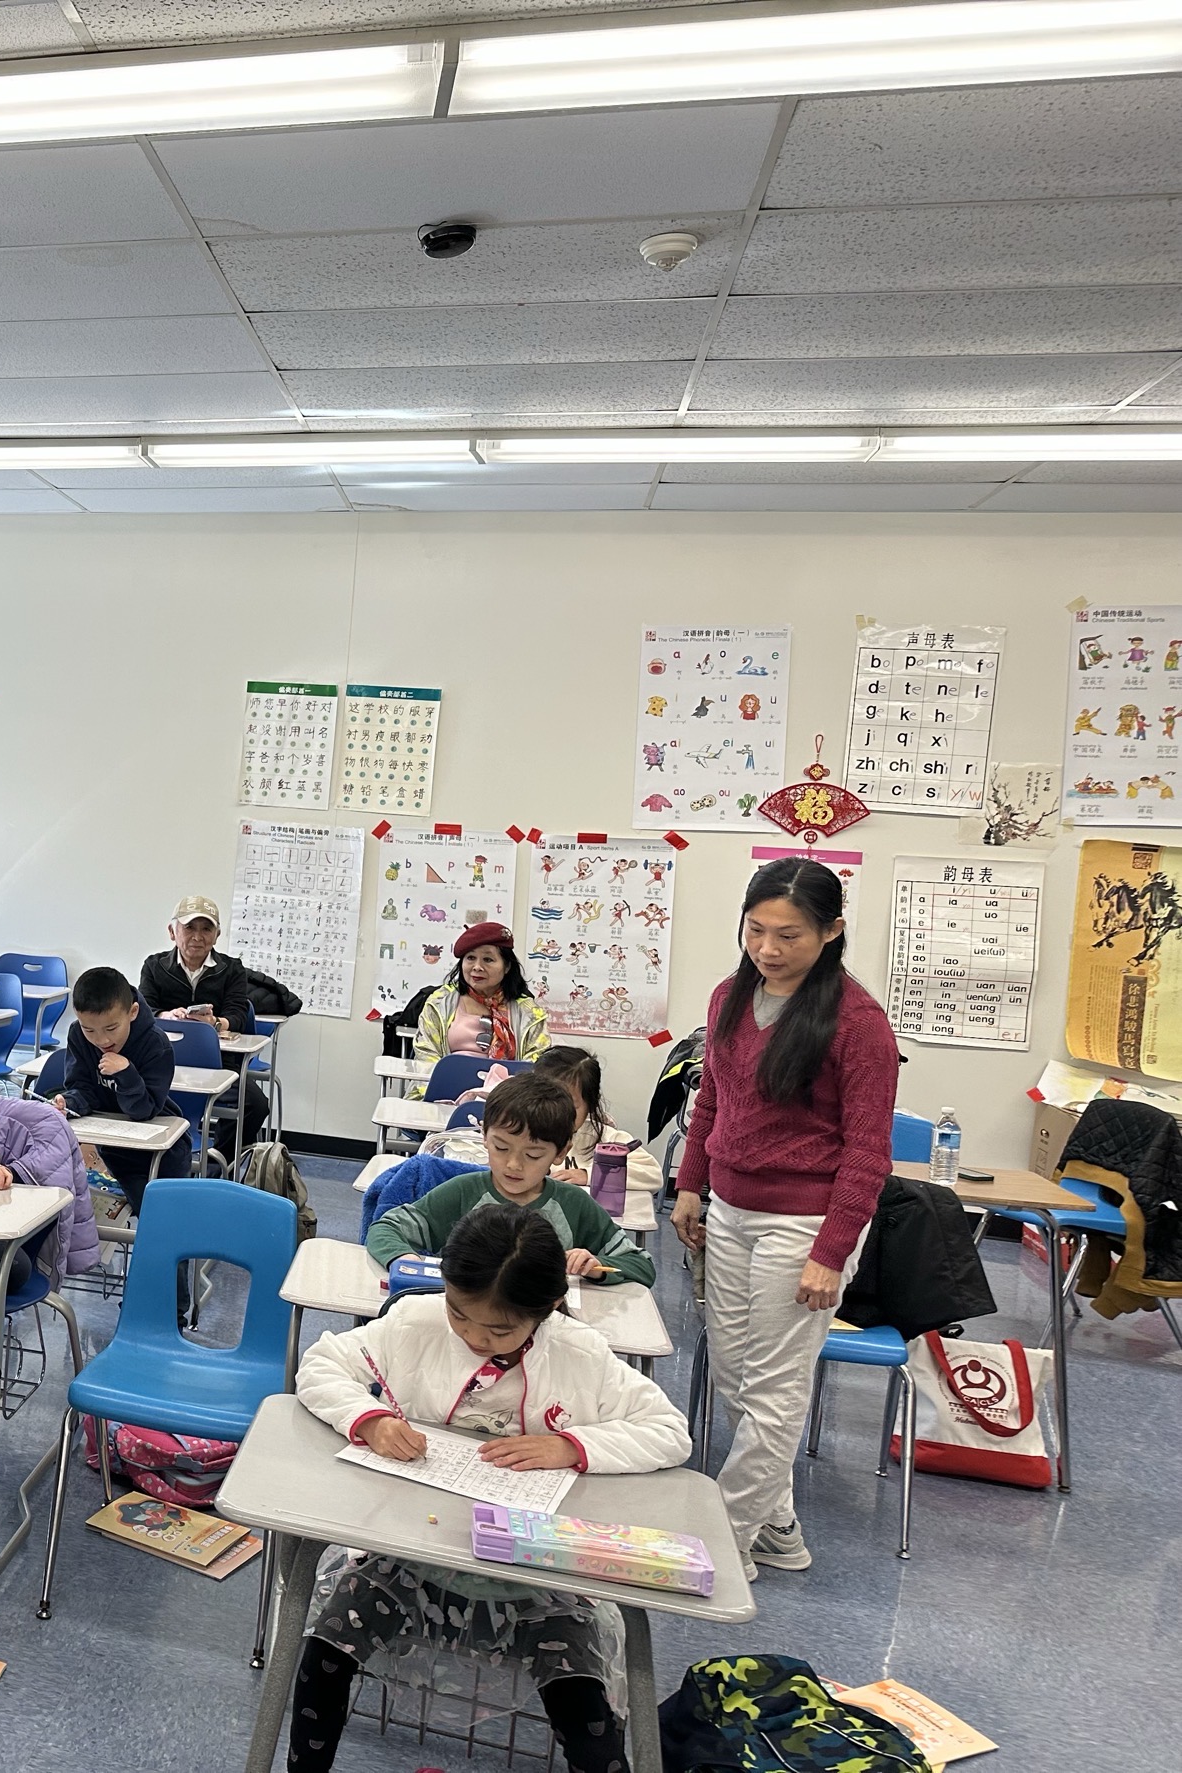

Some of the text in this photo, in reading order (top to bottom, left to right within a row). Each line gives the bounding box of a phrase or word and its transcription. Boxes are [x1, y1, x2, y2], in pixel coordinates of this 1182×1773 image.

[906, 632, 955, 649] 声母表
[720, 650, 726, 658] o
[772, 652, 779, 660] e
[720, 694, 727, 702] u
[670, 738, 775, 748] ai ei ui
[794, 788, 834, 826] 福
[406, 858, 505, 873] b p m
[943, 865, 992, 883] 韵母表
[404, 898, 502, 914] f d t
[982, 936, 998, 944] uai
[916, 943, 1005, 956] ei uei(ui)
[934, 968, 965, 977] iou(iu)
[402, 980, 408, 989] k
[940, 980, 956, 988] ian
[942, 991, 950, 999] in
[966, 993, 1001, 1002] uen(un)
[905, 1000, 996, 1013] ang iang uang
[904, 1011, 994, 1025] eng ing ueng
[902, 1023, 954, 1034] ong iong
[897, 1700, 917, 1713] Learn
[917, 1712, 944, 1730] Chinese
